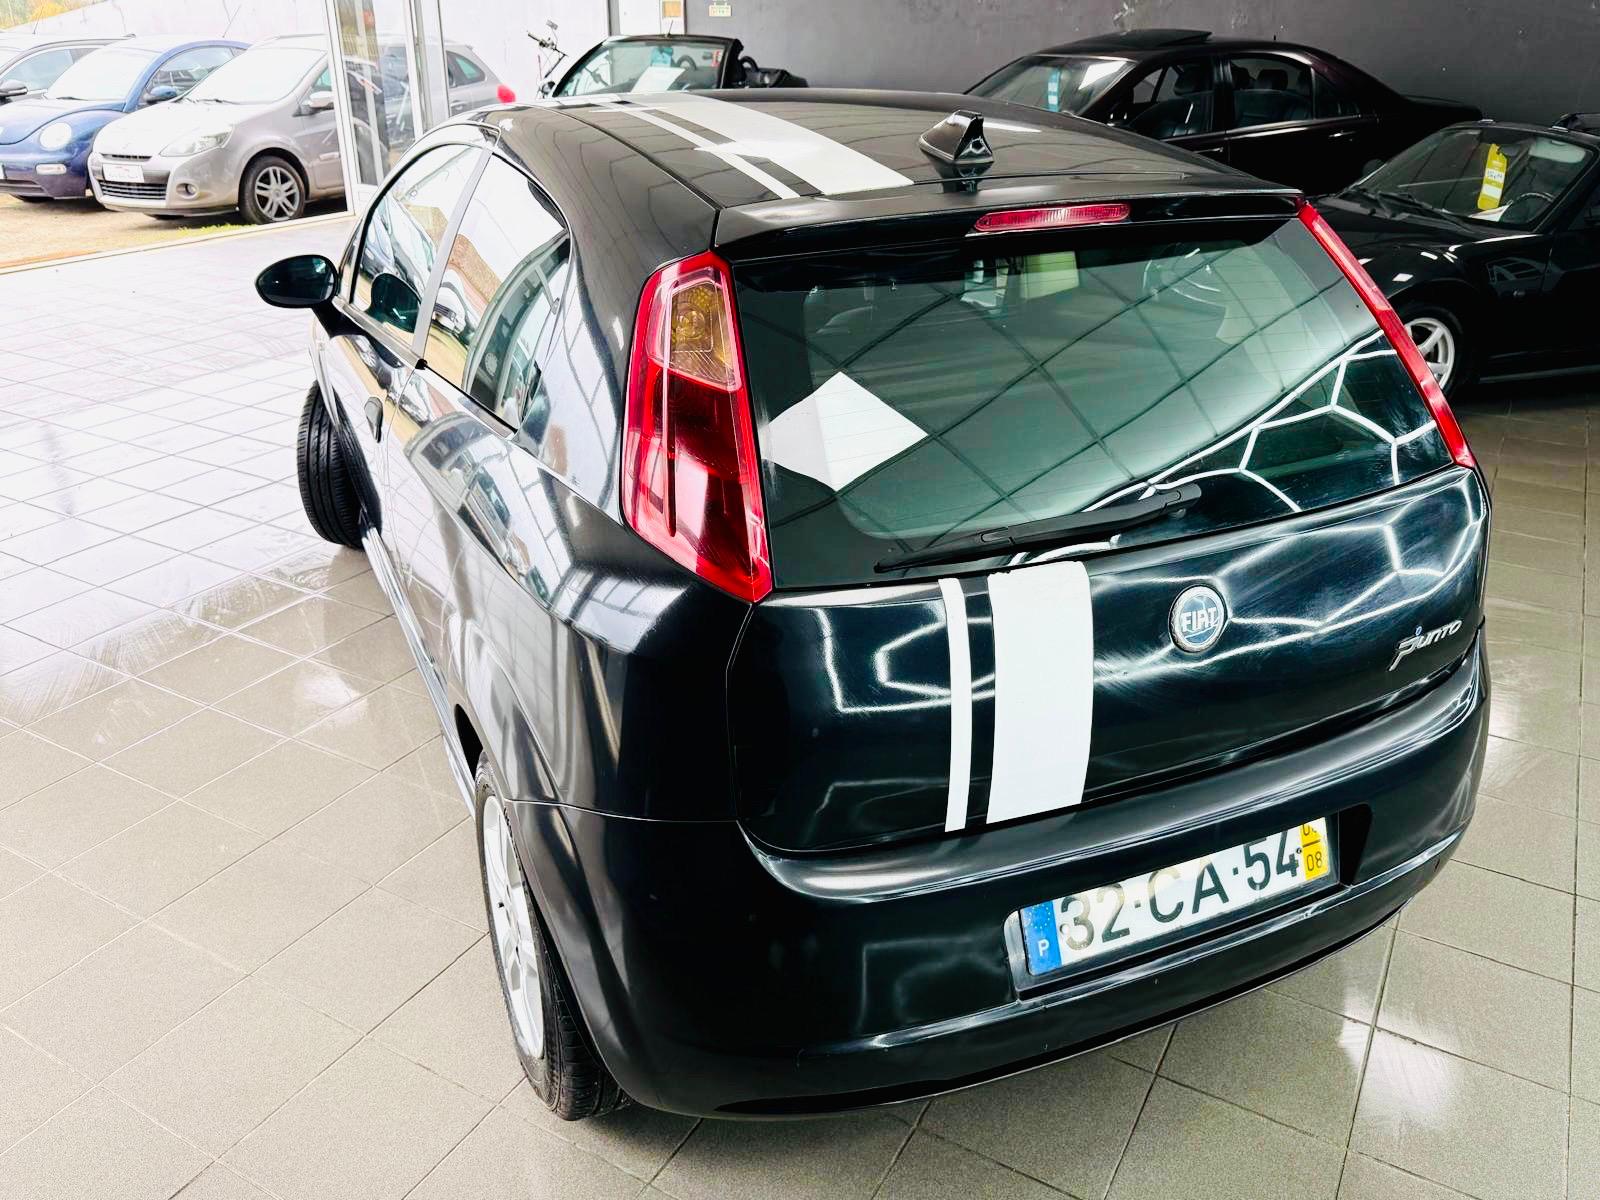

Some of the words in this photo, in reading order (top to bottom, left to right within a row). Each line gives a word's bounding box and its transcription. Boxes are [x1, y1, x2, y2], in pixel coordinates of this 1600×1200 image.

[1181, 607, 1217, 633] FIAT
[1306, 851, 1323, 872] 08
[1038, 938, 1050, 957] P
